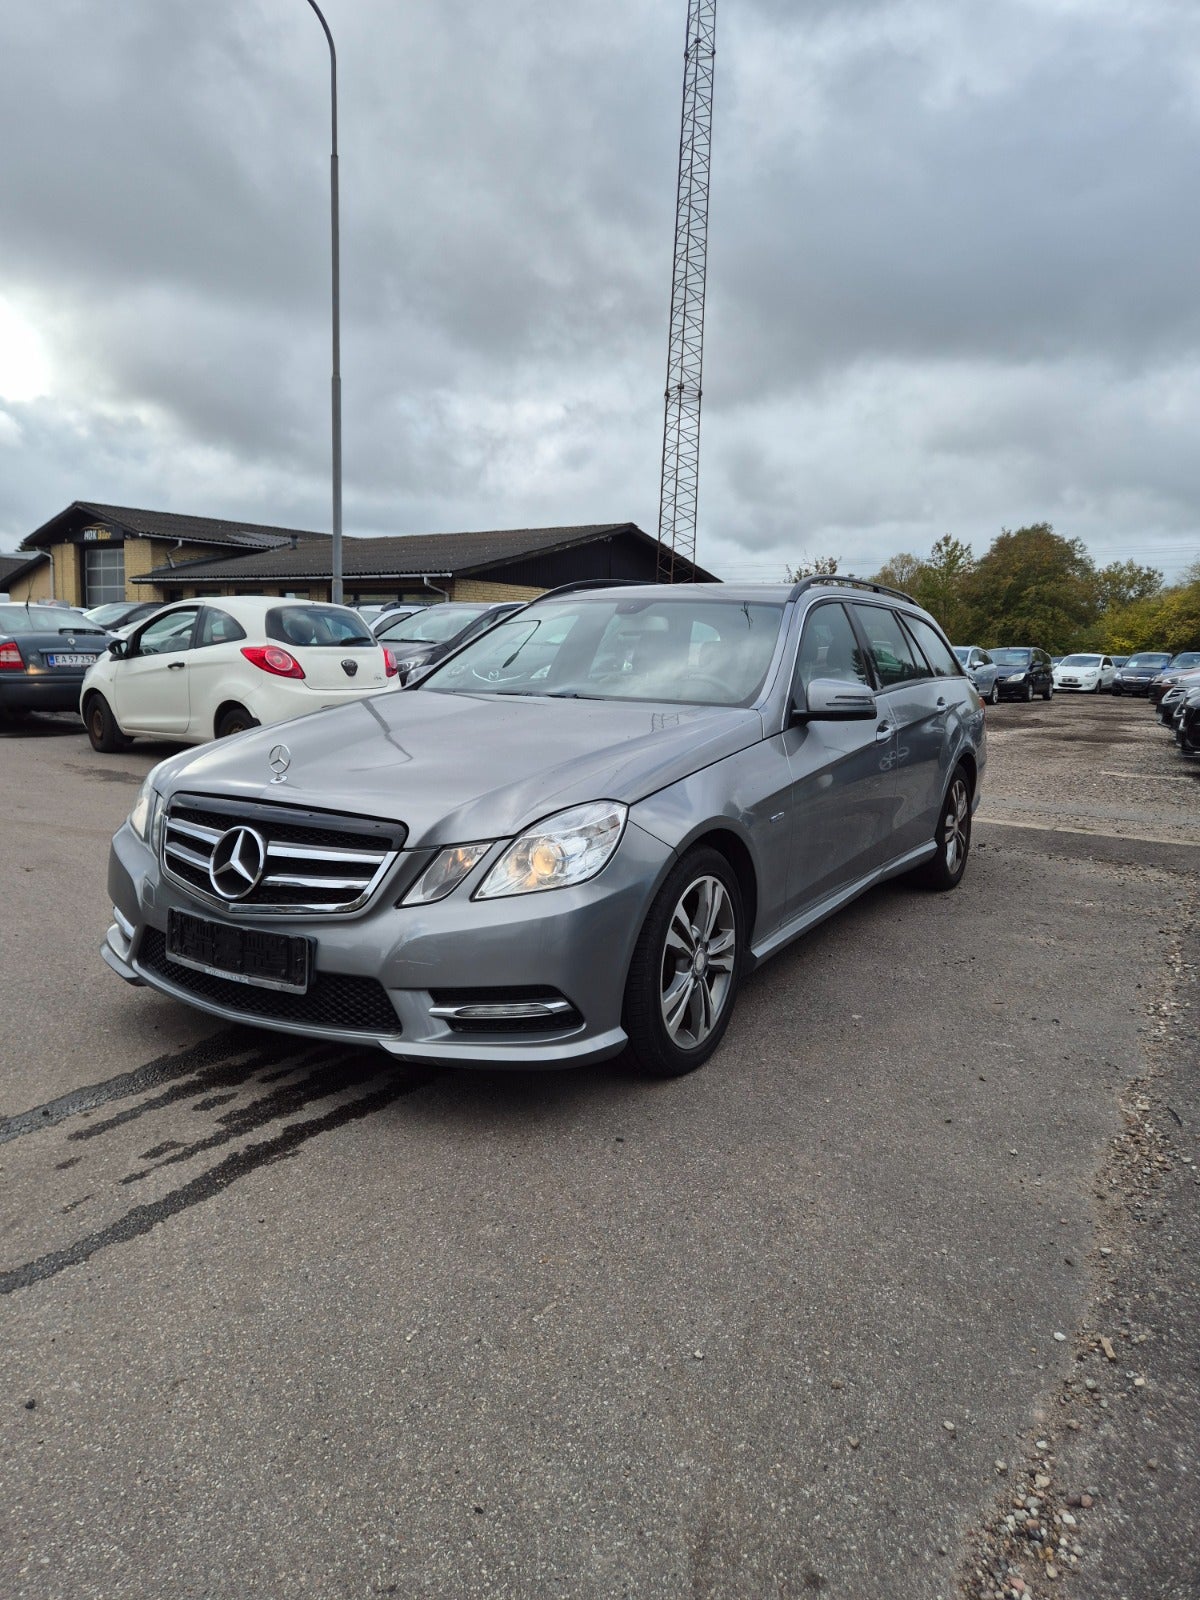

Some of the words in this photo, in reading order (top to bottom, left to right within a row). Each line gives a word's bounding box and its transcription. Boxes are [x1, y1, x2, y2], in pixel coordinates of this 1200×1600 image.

[55, 655, 67, 664] EA
[69, 655, 79, 664] 57
[81, 655, 96, 664] 252
